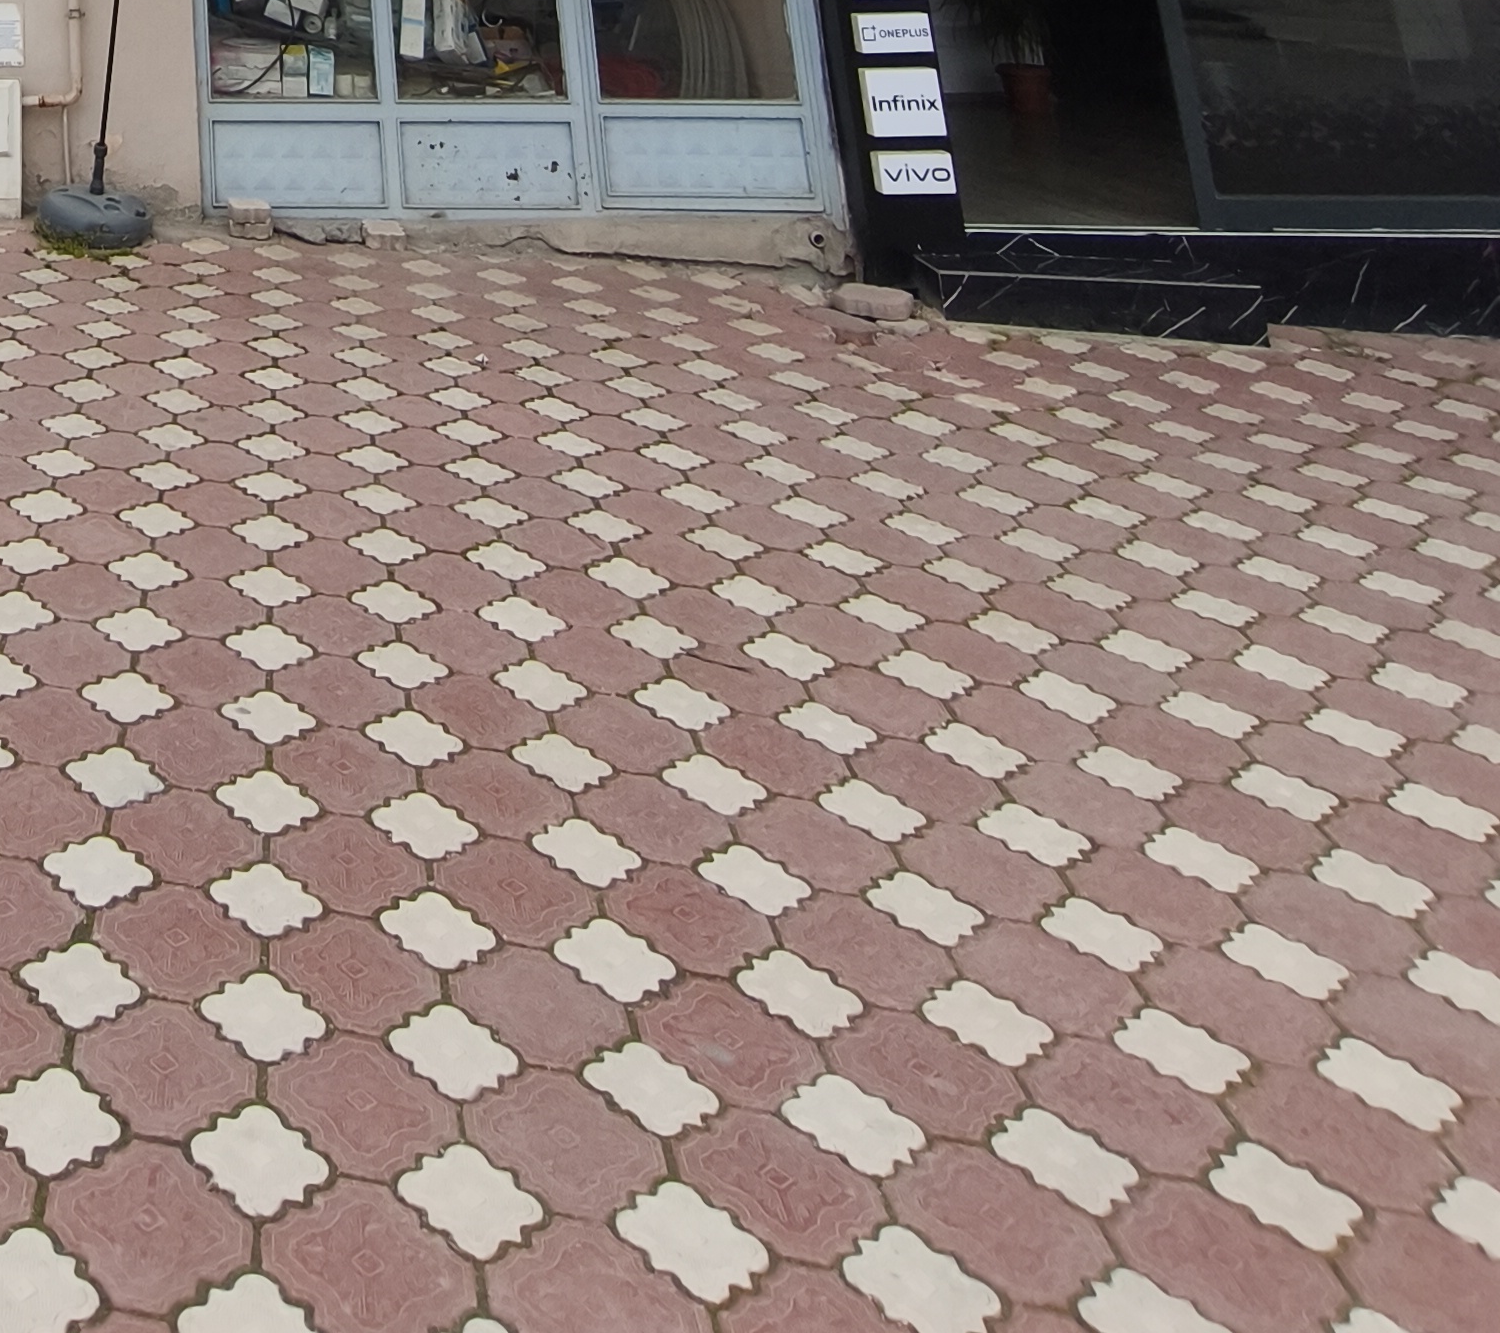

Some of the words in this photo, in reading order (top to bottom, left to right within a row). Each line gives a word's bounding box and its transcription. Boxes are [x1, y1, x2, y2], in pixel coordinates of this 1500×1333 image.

[879, 28, 929, 38] ONEPLUS
[872, 95, 939, 112] Infinix
[884, 164, 951, 182] vivo
